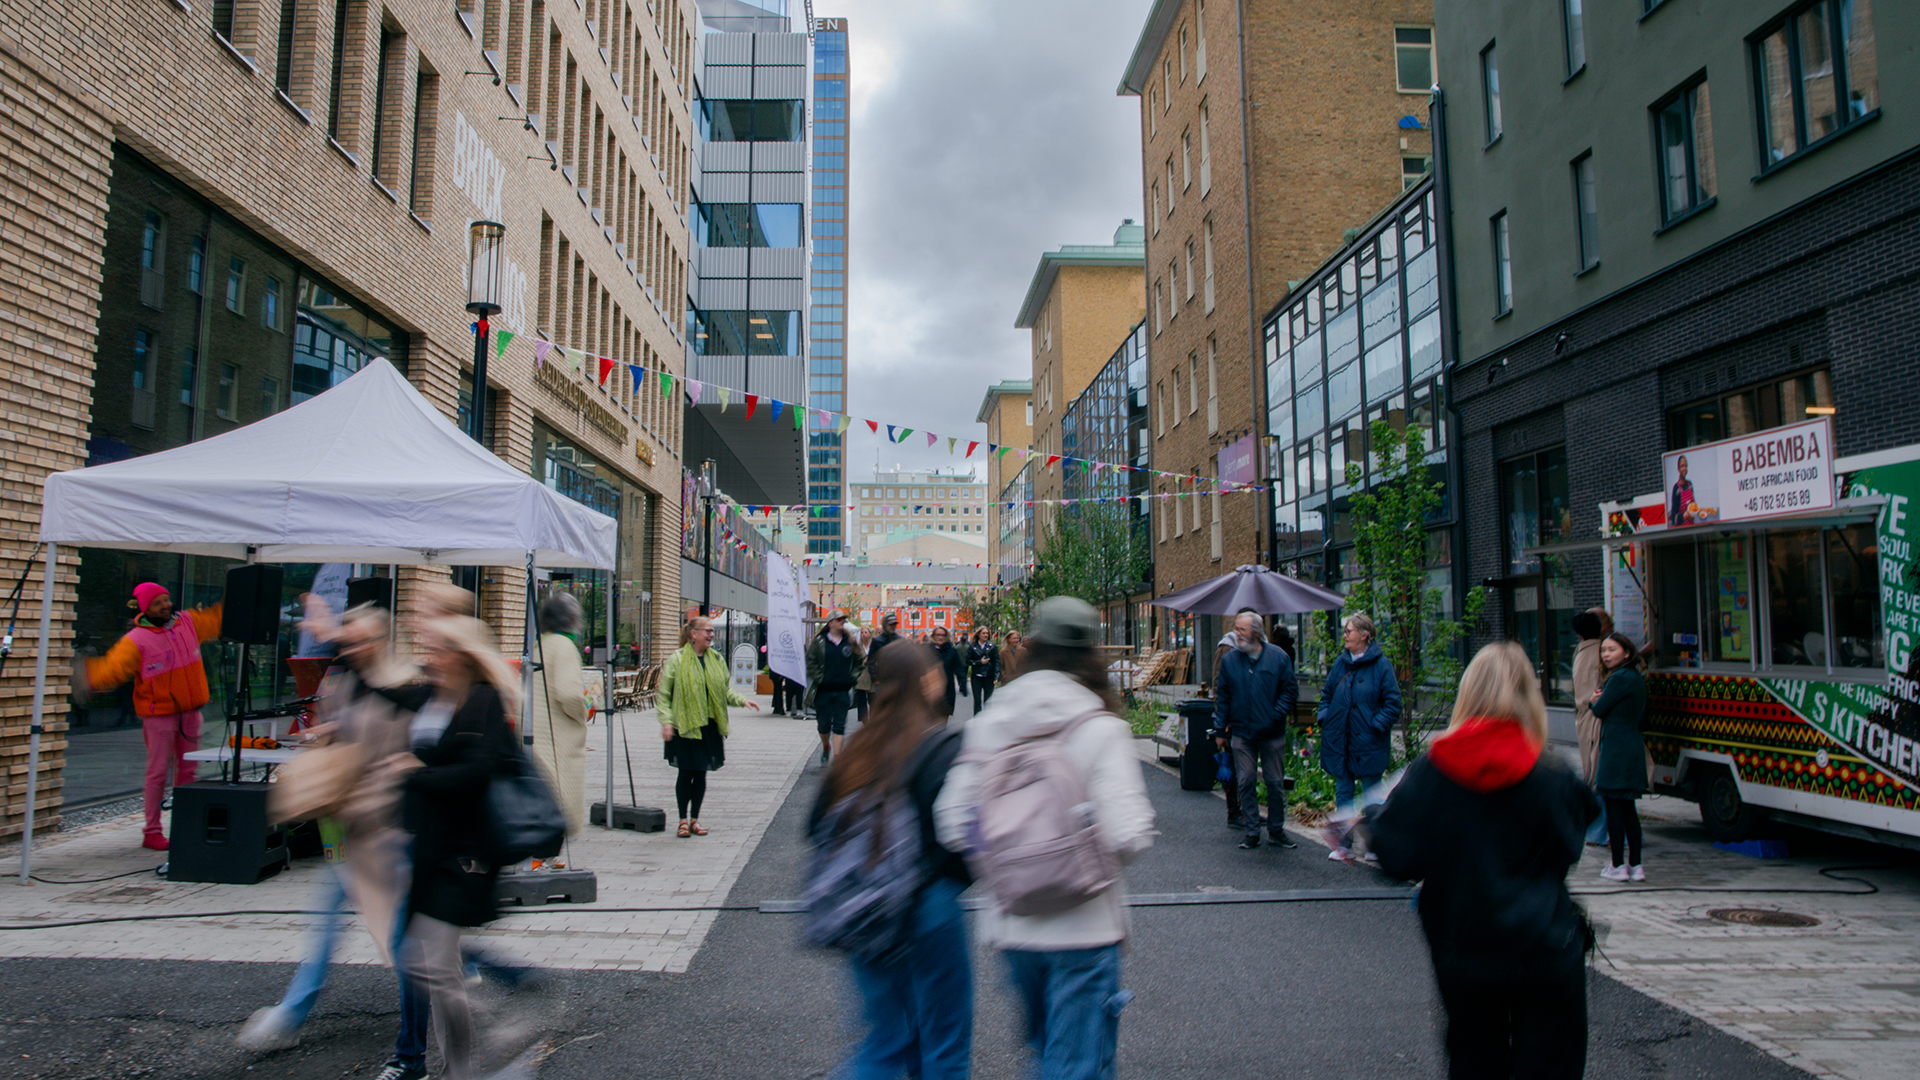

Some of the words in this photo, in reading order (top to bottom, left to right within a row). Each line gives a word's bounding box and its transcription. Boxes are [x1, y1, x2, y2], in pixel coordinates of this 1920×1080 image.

[453, 109, 506, 222] BRICK
[1732, 431, 1820, 474] BABEMBA
[1737, 476, 1759, 491] WEST
[1760, 470, 1795, 488] AFRICAN
[1796, 466, 1818, 482] FOOD
[1744, 496, 1758, 512] +46
[1759, 494, 1774, 511] 762
[1775, 492, 1785, 509] 52
[1787, 490, 1798, 507] 65
[1799, 488, 1810, 505] 89
[1880, 535, 1911, 561] SOUL
[1886, 610, 1909, 630] ARE
[1911, 616, 1920, 634] T
[1856, 685, 1899, 720] HAPPY
